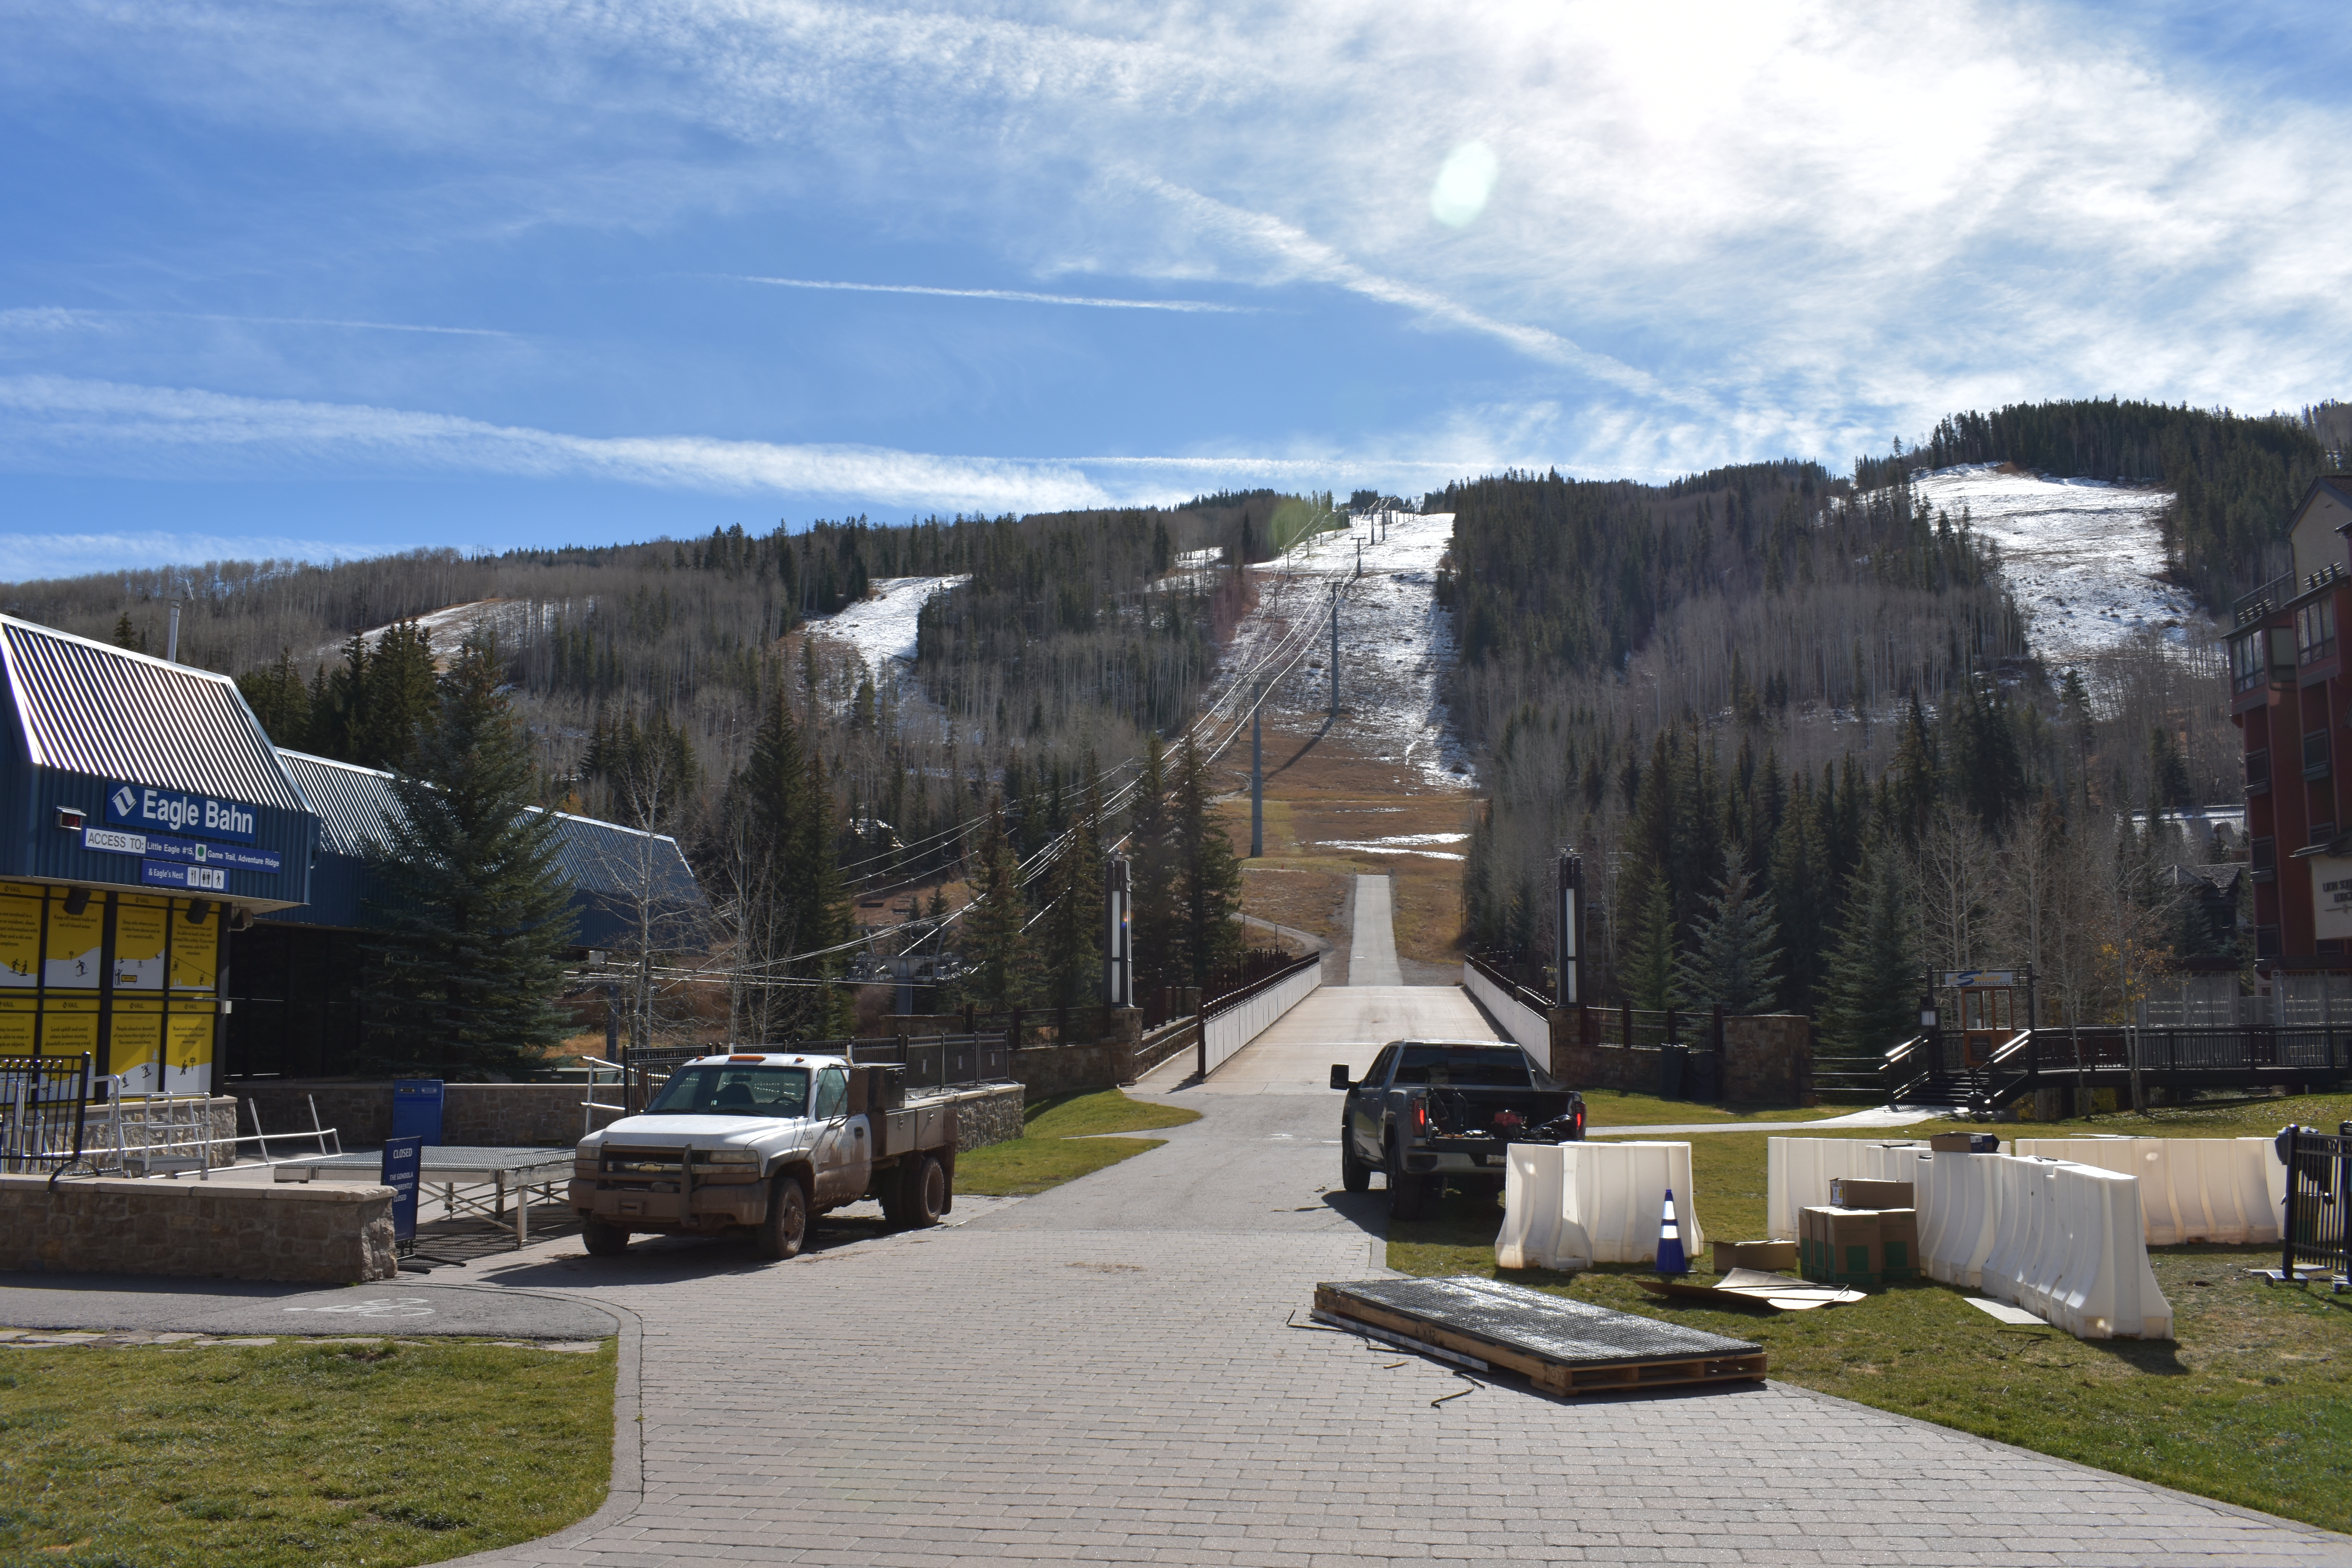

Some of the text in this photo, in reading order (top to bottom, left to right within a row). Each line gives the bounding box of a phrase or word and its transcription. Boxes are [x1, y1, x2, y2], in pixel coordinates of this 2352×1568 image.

[143, 789, 252, 833] Eagle Bahn
[88, 832, 194, 856] ACCESS TO: Little Eagle #15,
[207, 850, 279, 867] Game Trail, Adventure Ridge
[154, 869, 171, 878] Eagle's
[2323, 881, 2338, 892] LION
[804, 1131, 813, 1140] 203
[393, 1148, 412, 1159] CLOSED
[397, 1172, 413, 1180] GONDOLA
[394, 1183, 413, 1191] CURRENTLY
[1429, 1329, 1436, 1342] 12
